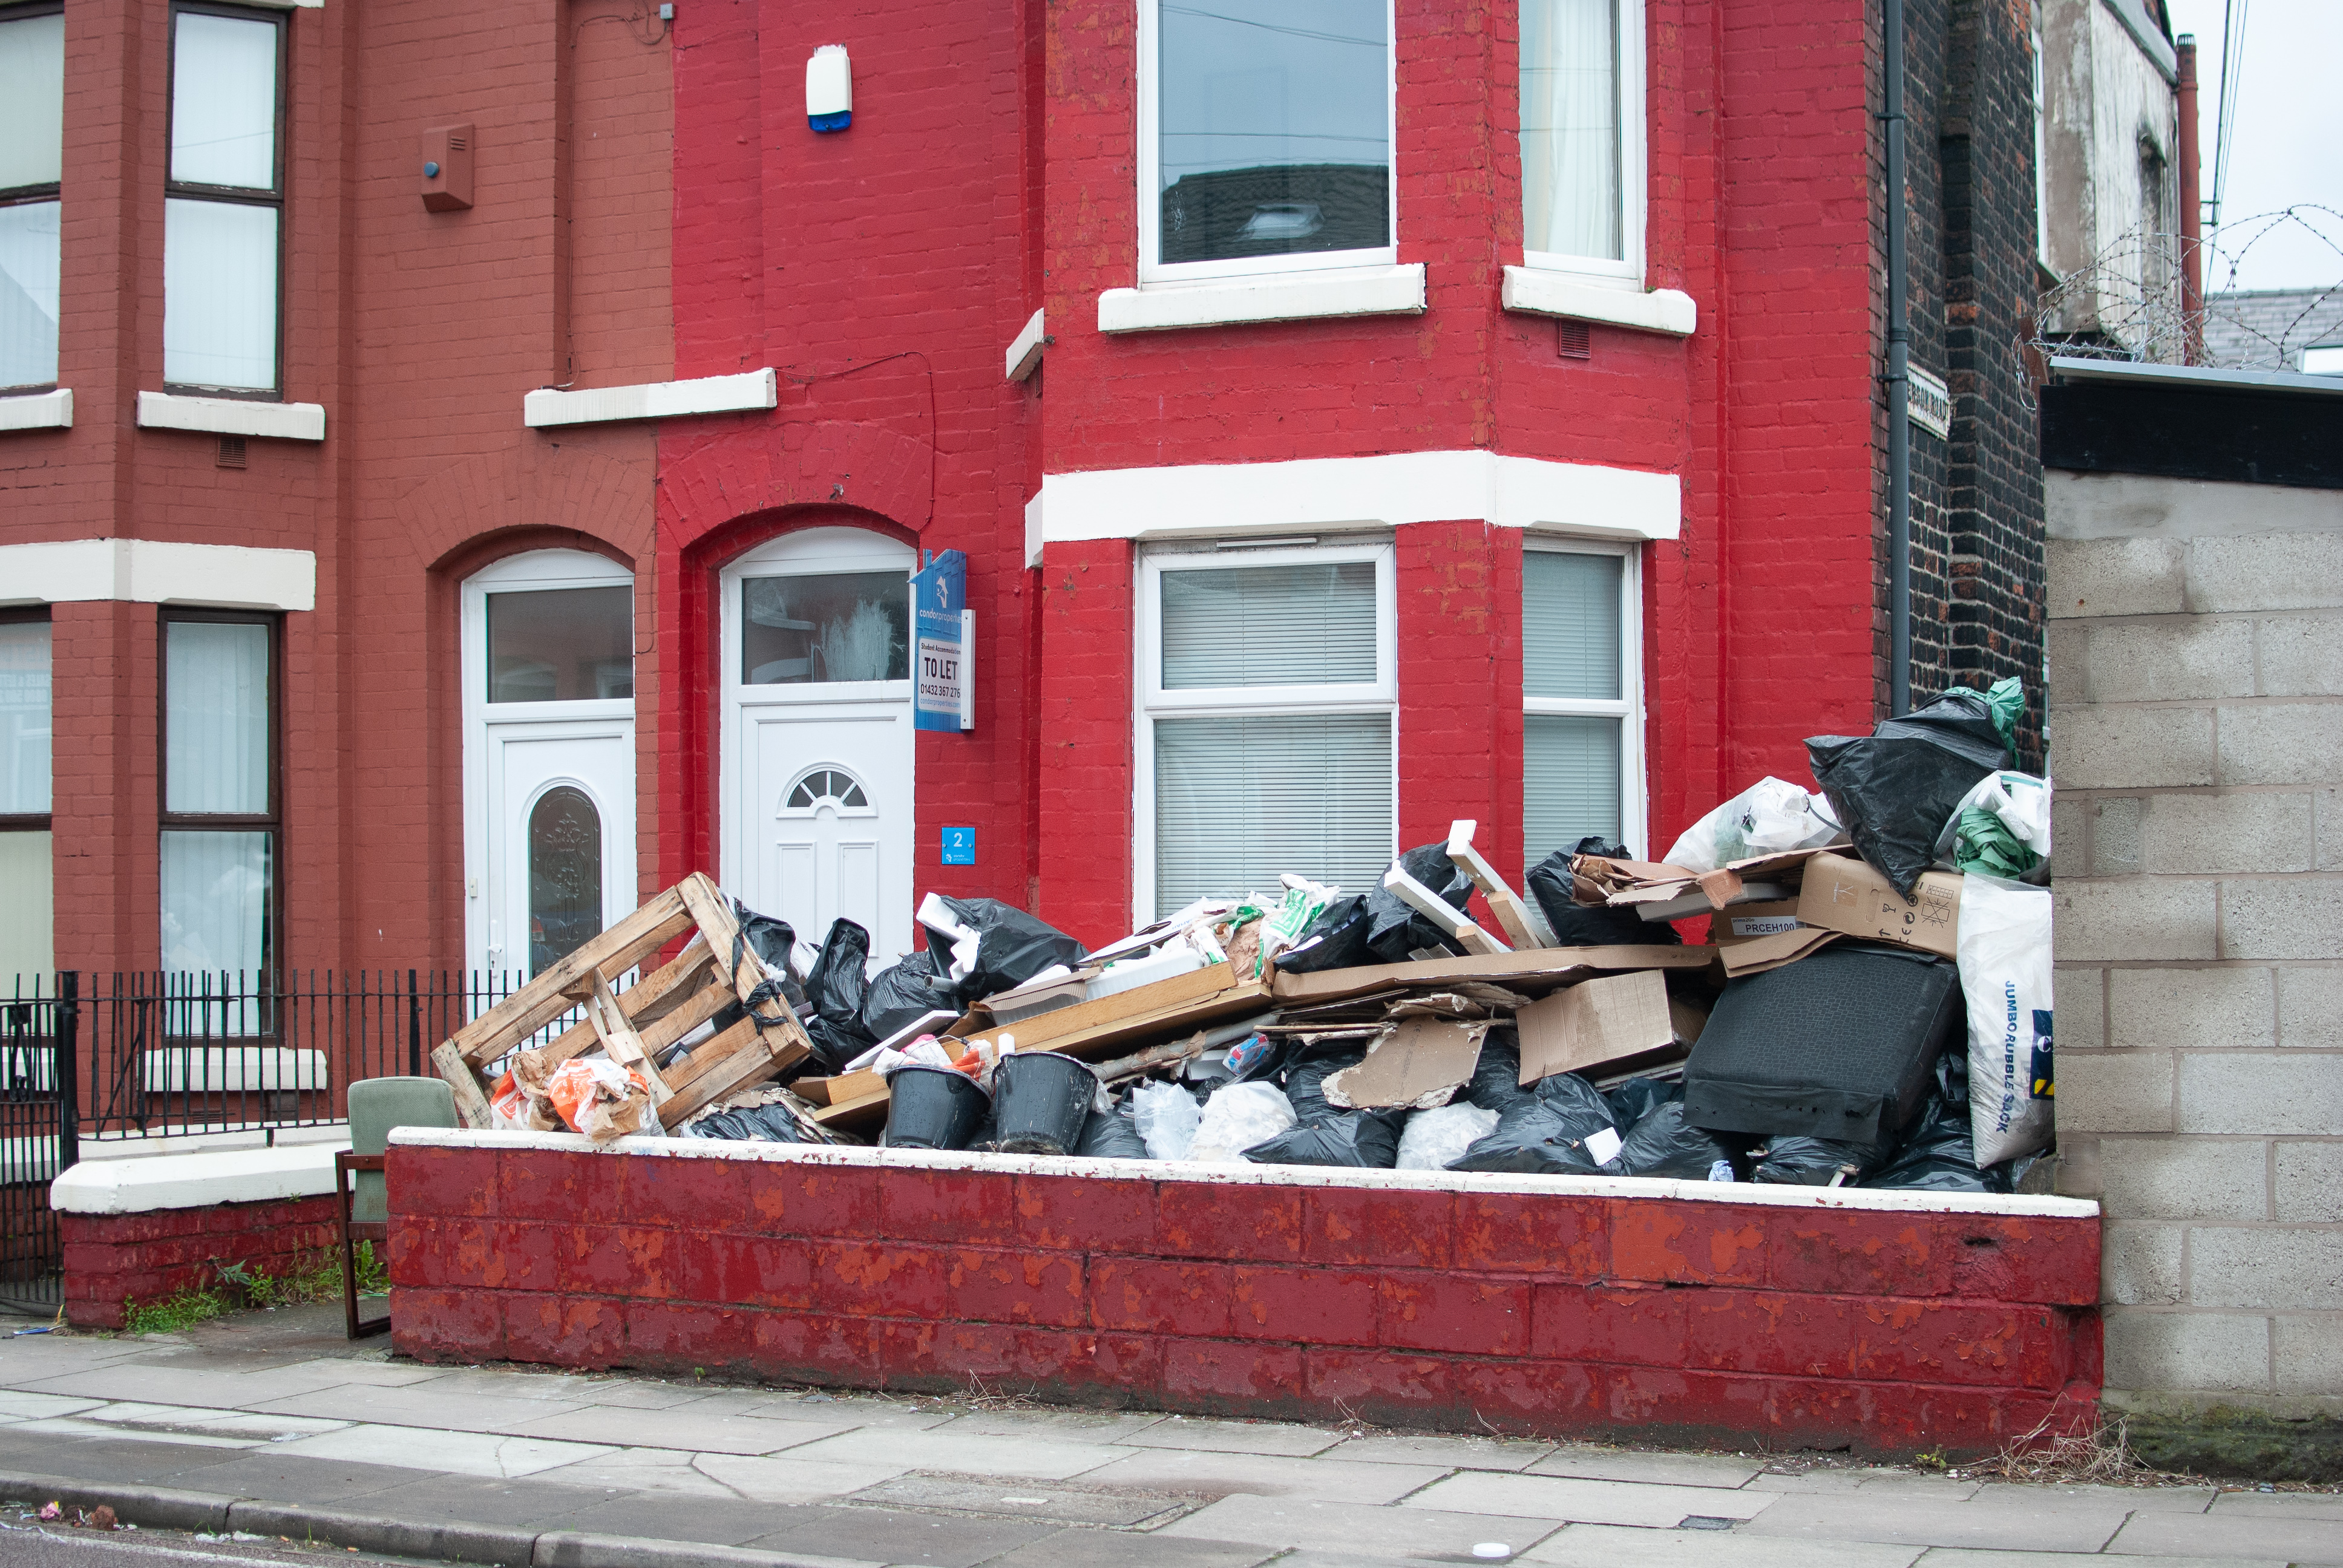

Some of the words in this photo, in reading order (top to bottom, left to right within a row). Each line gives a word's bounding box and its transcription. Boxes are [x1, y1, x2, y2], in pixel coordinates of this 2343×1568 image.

[921, 642, 935, 651] Student
[925, 657, 937, 678] TO
[940, 659, 957, 681] LET
[920, 684, 938, 696] 01432
[939, 685, 949, 697] 367
[950, 687, 960, 699] 276
[954, 832, 962, 847] 2
[1745, 923, 1794, 933] PRCEH100
[2005, 980, 2018, 1032] JUMBO
[2037, 1035, 2052, 1053] C
[2004, 1033, 2017, 1091] RUBBLE
[1996, 1092, 2015, 1134] SACK
